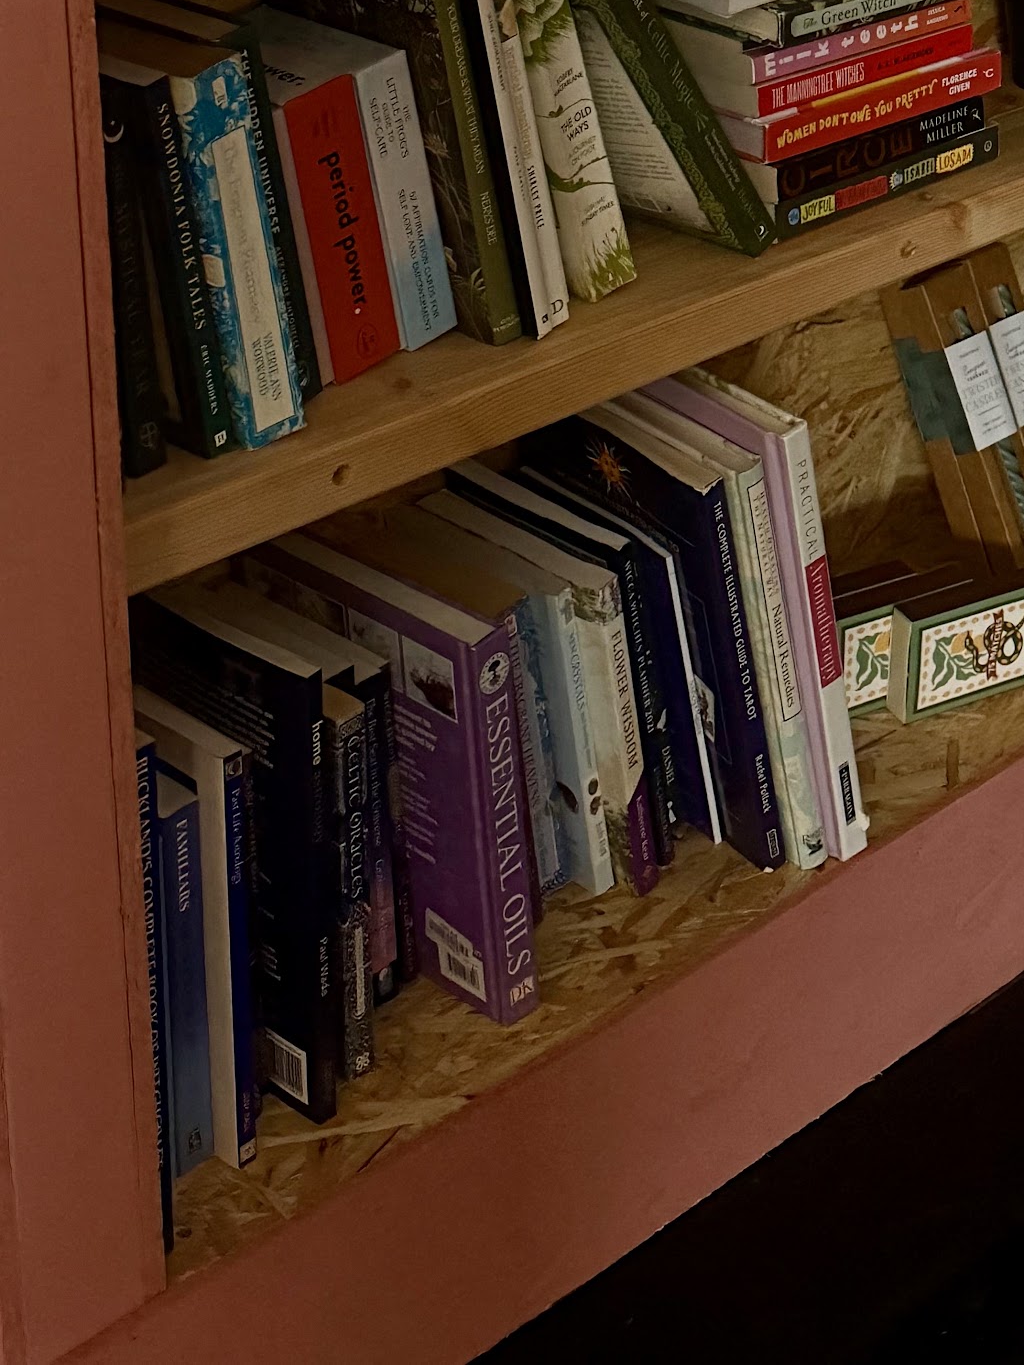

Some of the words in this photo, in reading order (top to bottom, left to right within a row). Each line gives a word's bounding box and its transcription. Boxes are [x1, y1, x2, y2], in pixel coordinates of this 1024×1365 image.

[445, 1, 460, 34] YOUR
[635, 8, 652, 22] of
[821, 7, 859, 26] Green
[385, 75, 401, 117] LITTLE
[658, 59, 703, 113] Magic
[772, 87, 786, 110] THE
[836, 61, 866, 89] WITCHES
[941, 68, 978, 87] FLORENCE
[948, 81, 972, 97] GIVEN
[466, 115, 480, 142] THEY
[560, 118, 574, 134] THE
[574, 106, 592, 124] OLD
[566, 121, 590, 142] WAYS
[776, 122, 817, 149] WOMEN
[819, 112, 849, 133] DON'T
[850, 106, 873, 127] OWE
[874, 99, 894, 120] YOU
[895, 79, 939, 110] PRETTY
[919, 105, 969, 133] MADELINE
[926, 120, 965, 145] MILLER
[155, 102, 187, 217] SNOWDONIA
[243, 86, 265, 152] HIDDEN
[257, 155, 281, 234] UNIVERSE
[471, 142, 486, 175] MEAN
[316, 145, 360, 234] period
[525, 163, 540, 202] SHIRLEY
[801, 195, 835, 222] JOYFUL
[937, 145, 973, 171] LOSADA
[479, 191, 494, 225] NERYS
[532, 202, 545, 231] PRICE
[175, 218, 197, 266] FOLK
[484, 223, 498, 246] DEE
[331, 230, 371, 320] power.
[185, 273, 209, 331] TALES
[199, 342, 211, 366] ERIC
[710, 497, 725, 522] THE
[794, 457, 821, 563] PRACTICAL
[713, 519, 734, 575] COMPLETE
[623, 559, 637, 600] WICCA
[722, 574, 744, 639] ILLUSTRATED
[770, 602, 788, 649] Natural
[805, 559, 841, 685] Aromatherapy
[733, 637, 749, 669] GUIDE
[989, 616, 1002, 662] MATCHES
[609, 629, 630, 696] FLOWER
[636, 655, 653, 710] PLANNER
[738, 669, 752, 685] TO
[777, 648, 798, 710] Remedies
[643, 709, 656, 734] 2021
[741, 685, 758, 721] TAROT
[310, 715, 325, 770] home
[618, 700, 639, 770] WISDOM
[753, 754, 769, 782] Rachel
[230, 786, 241, 810] Past
[484, 691, 524, 893] ESSENTIAL
[756, 783, 773, 814] Pollack
[135, 755, 153, 873] BUCKLAND'S
[231, 810, 242, 834] Life
[173, 818, 191, 914] FAMILIARS
[318, 934, 328, 964] Paul
[501, 892, 533, 976] OILS
[319, 961, 331, 999] Wade
